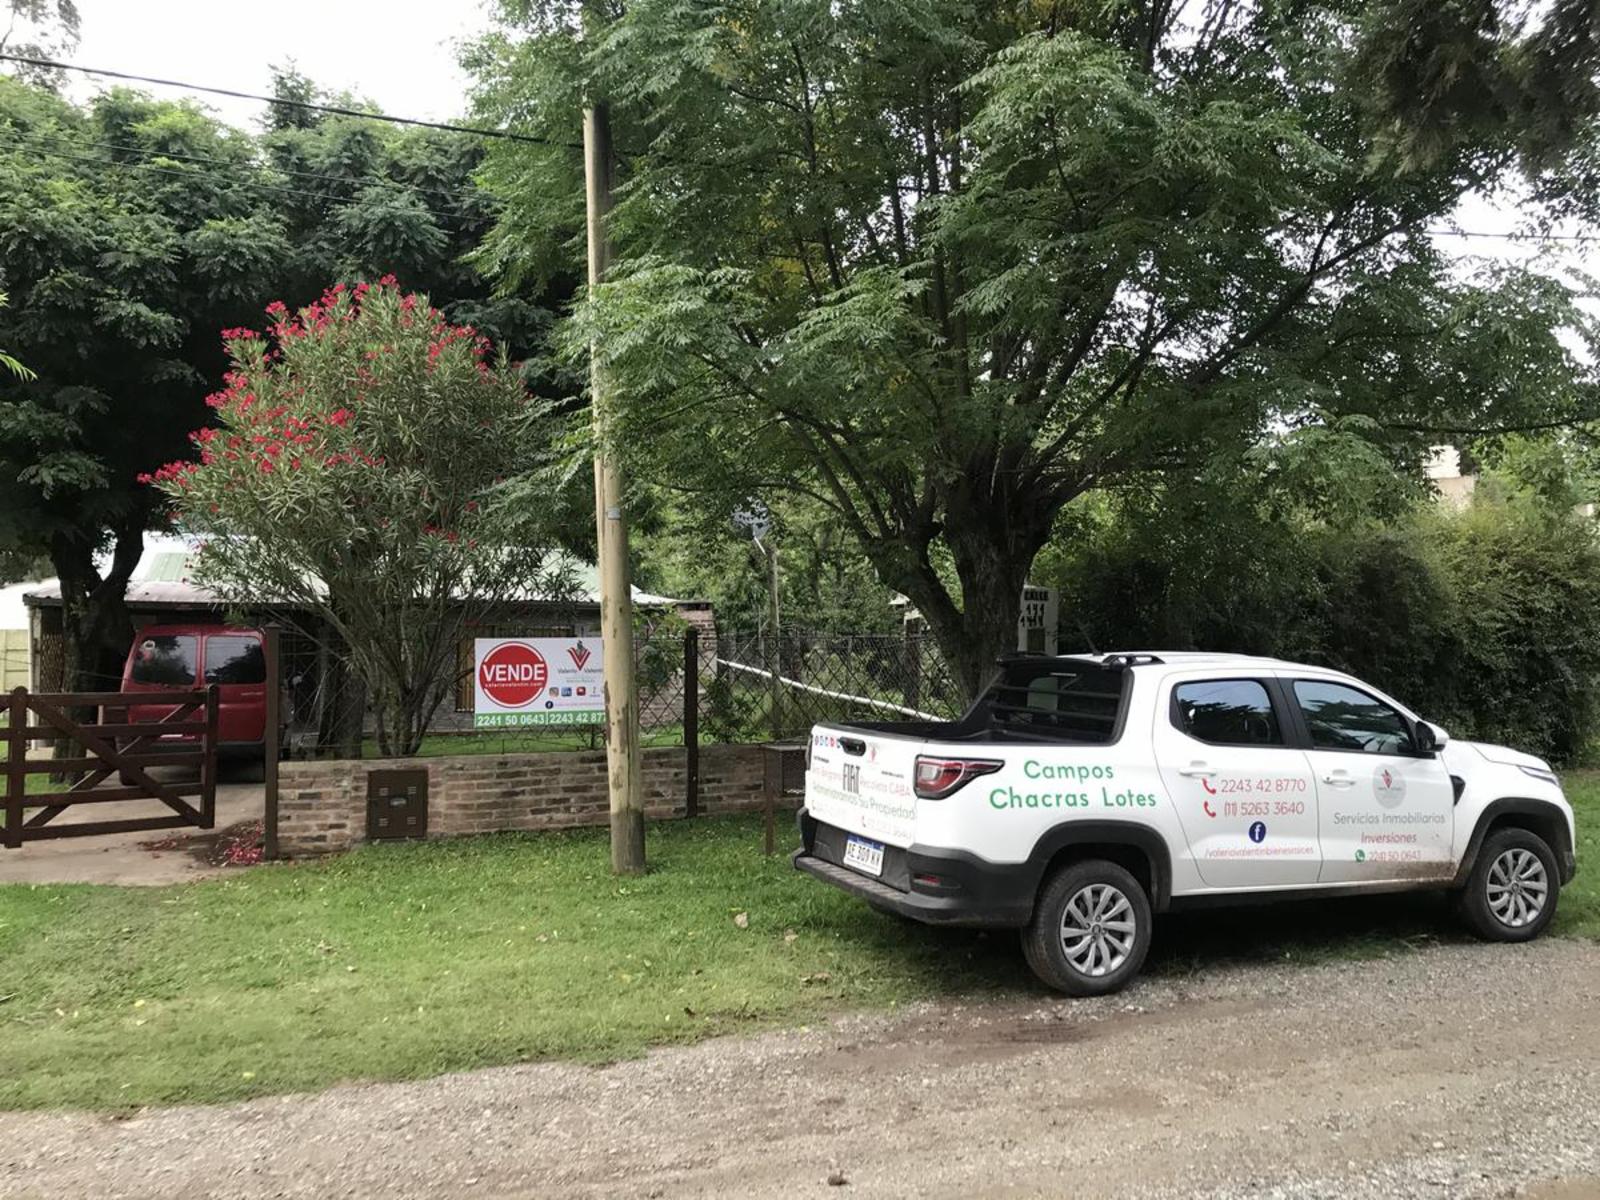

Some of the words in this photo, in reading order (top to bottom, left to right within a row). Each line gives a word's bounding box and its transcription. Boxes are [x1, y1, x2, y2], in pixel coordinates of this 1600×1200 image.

[482, 664, 545, 682] VENDE
[477, 715, 500, 727] 2241
[505, 714, 518, 726] 50
[520, 714, 545, 725] 0643
[550, 713, 573, 724] 2243
[576, 712, 587, 723] 42
[842, 763, 860, 794] FIAT
[1023, 759, 1114, 784] Campos
[1221, 779, 1252, 793] 2243
[1256, 779, 1272, 793] 42
[1275, 778, 1306, 792] 8770
[989, 786, 1089, 809] Chacras
[1102, 786, 1157, 807] Lotes
[1240, 802, 1270, 816] 5263
[1273, 801, 1305, 815] 3640
[1334, 812, 1380, 825] Servicios
[1382, 812, 1446, 824] Inmobiliarios
[1360, 831, 1417, 844] Inversiones
